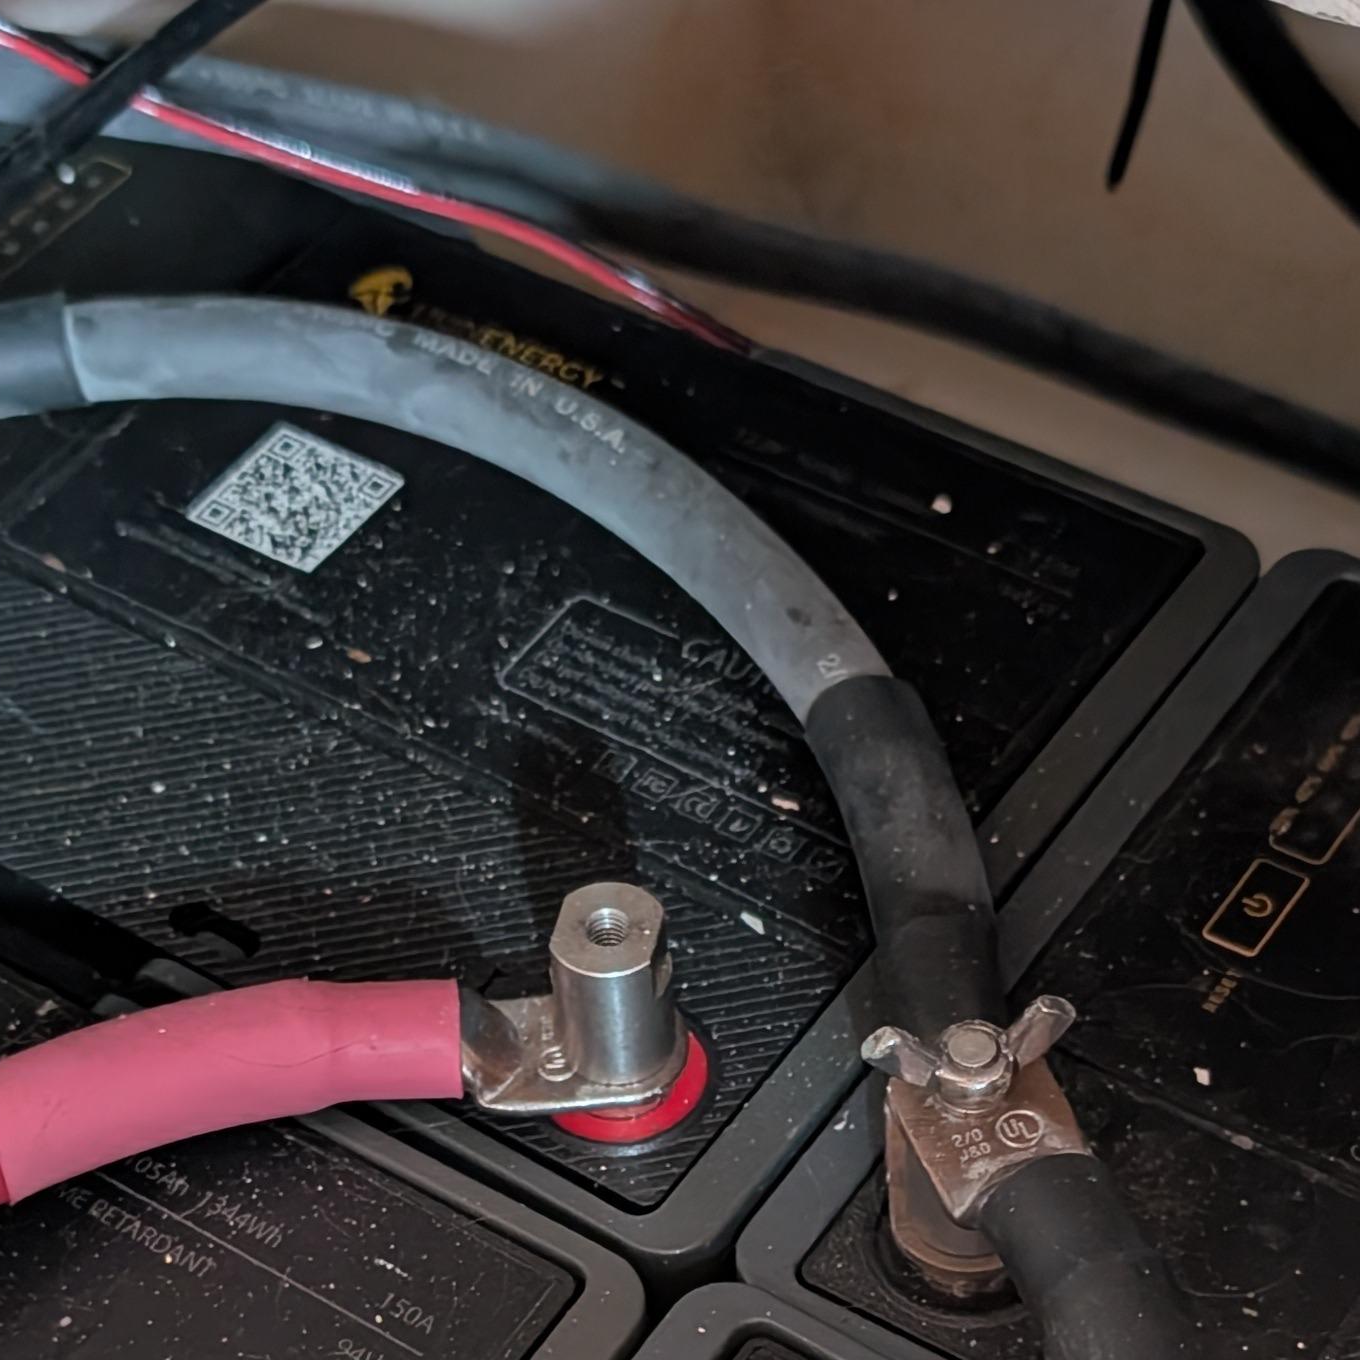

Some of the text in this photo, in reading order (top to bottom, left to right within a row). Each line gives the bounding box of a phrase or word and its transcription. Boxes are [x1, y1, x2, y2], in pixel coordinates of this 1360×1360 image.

[413, 330, 628, 456] MADE IN U.S.A.
[88, 1197, 218, 1279] RETARDANT
[380, 1291, 436, 1336] 150A
